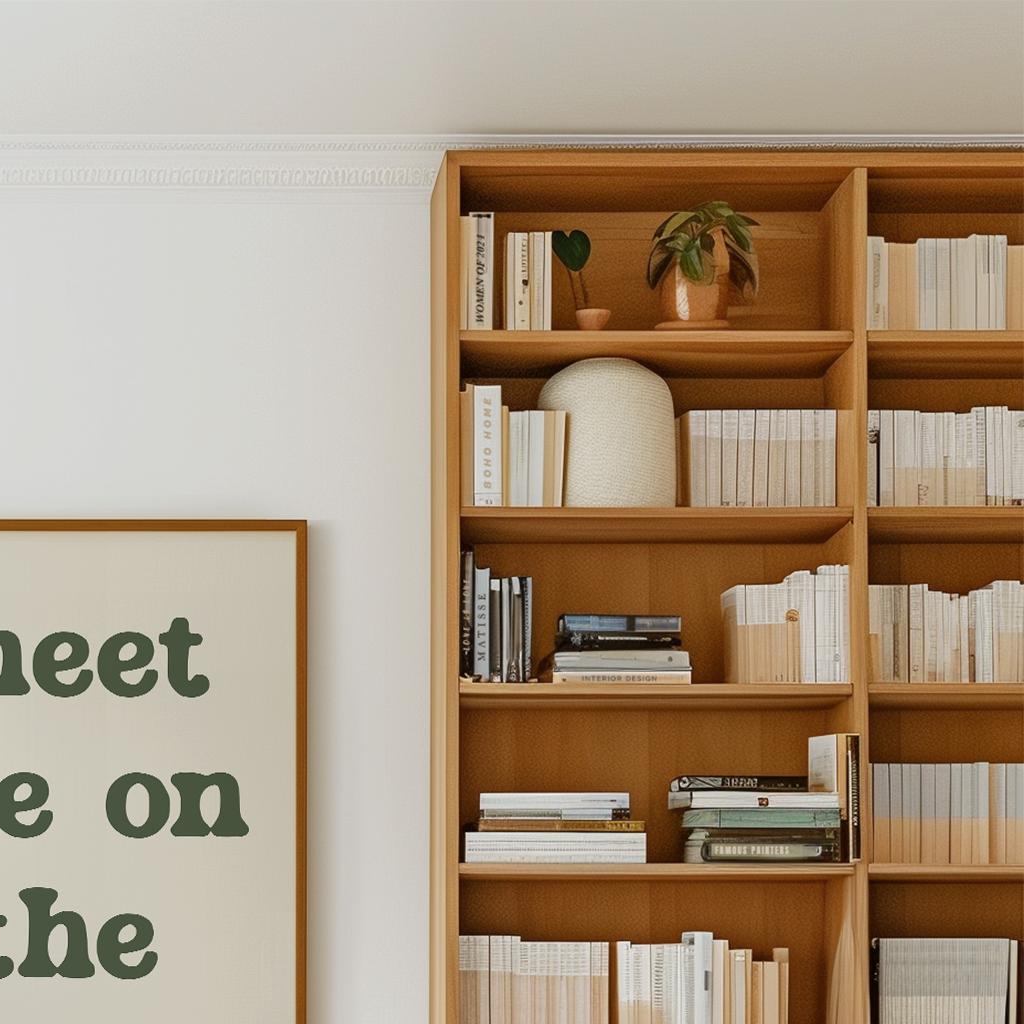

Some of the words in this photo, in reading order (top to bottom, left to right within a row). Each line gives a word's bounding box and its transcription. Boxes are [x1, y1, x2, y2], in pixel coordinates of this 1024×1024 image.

[477, 234, 485, 258] 2024
[476, 260, 485, 276] OF
[476, 278, 484, 323] WOMEN
[483, 398, 492, 440] HOME
[483, 447, 492, 489] BOHO
[477, 593, 487, 662] MATISSE
[106, 772, 249, 838] on
[714, 845, 748, 855] FAMOUS
[751, 845, 790, 855] PAINTERS
